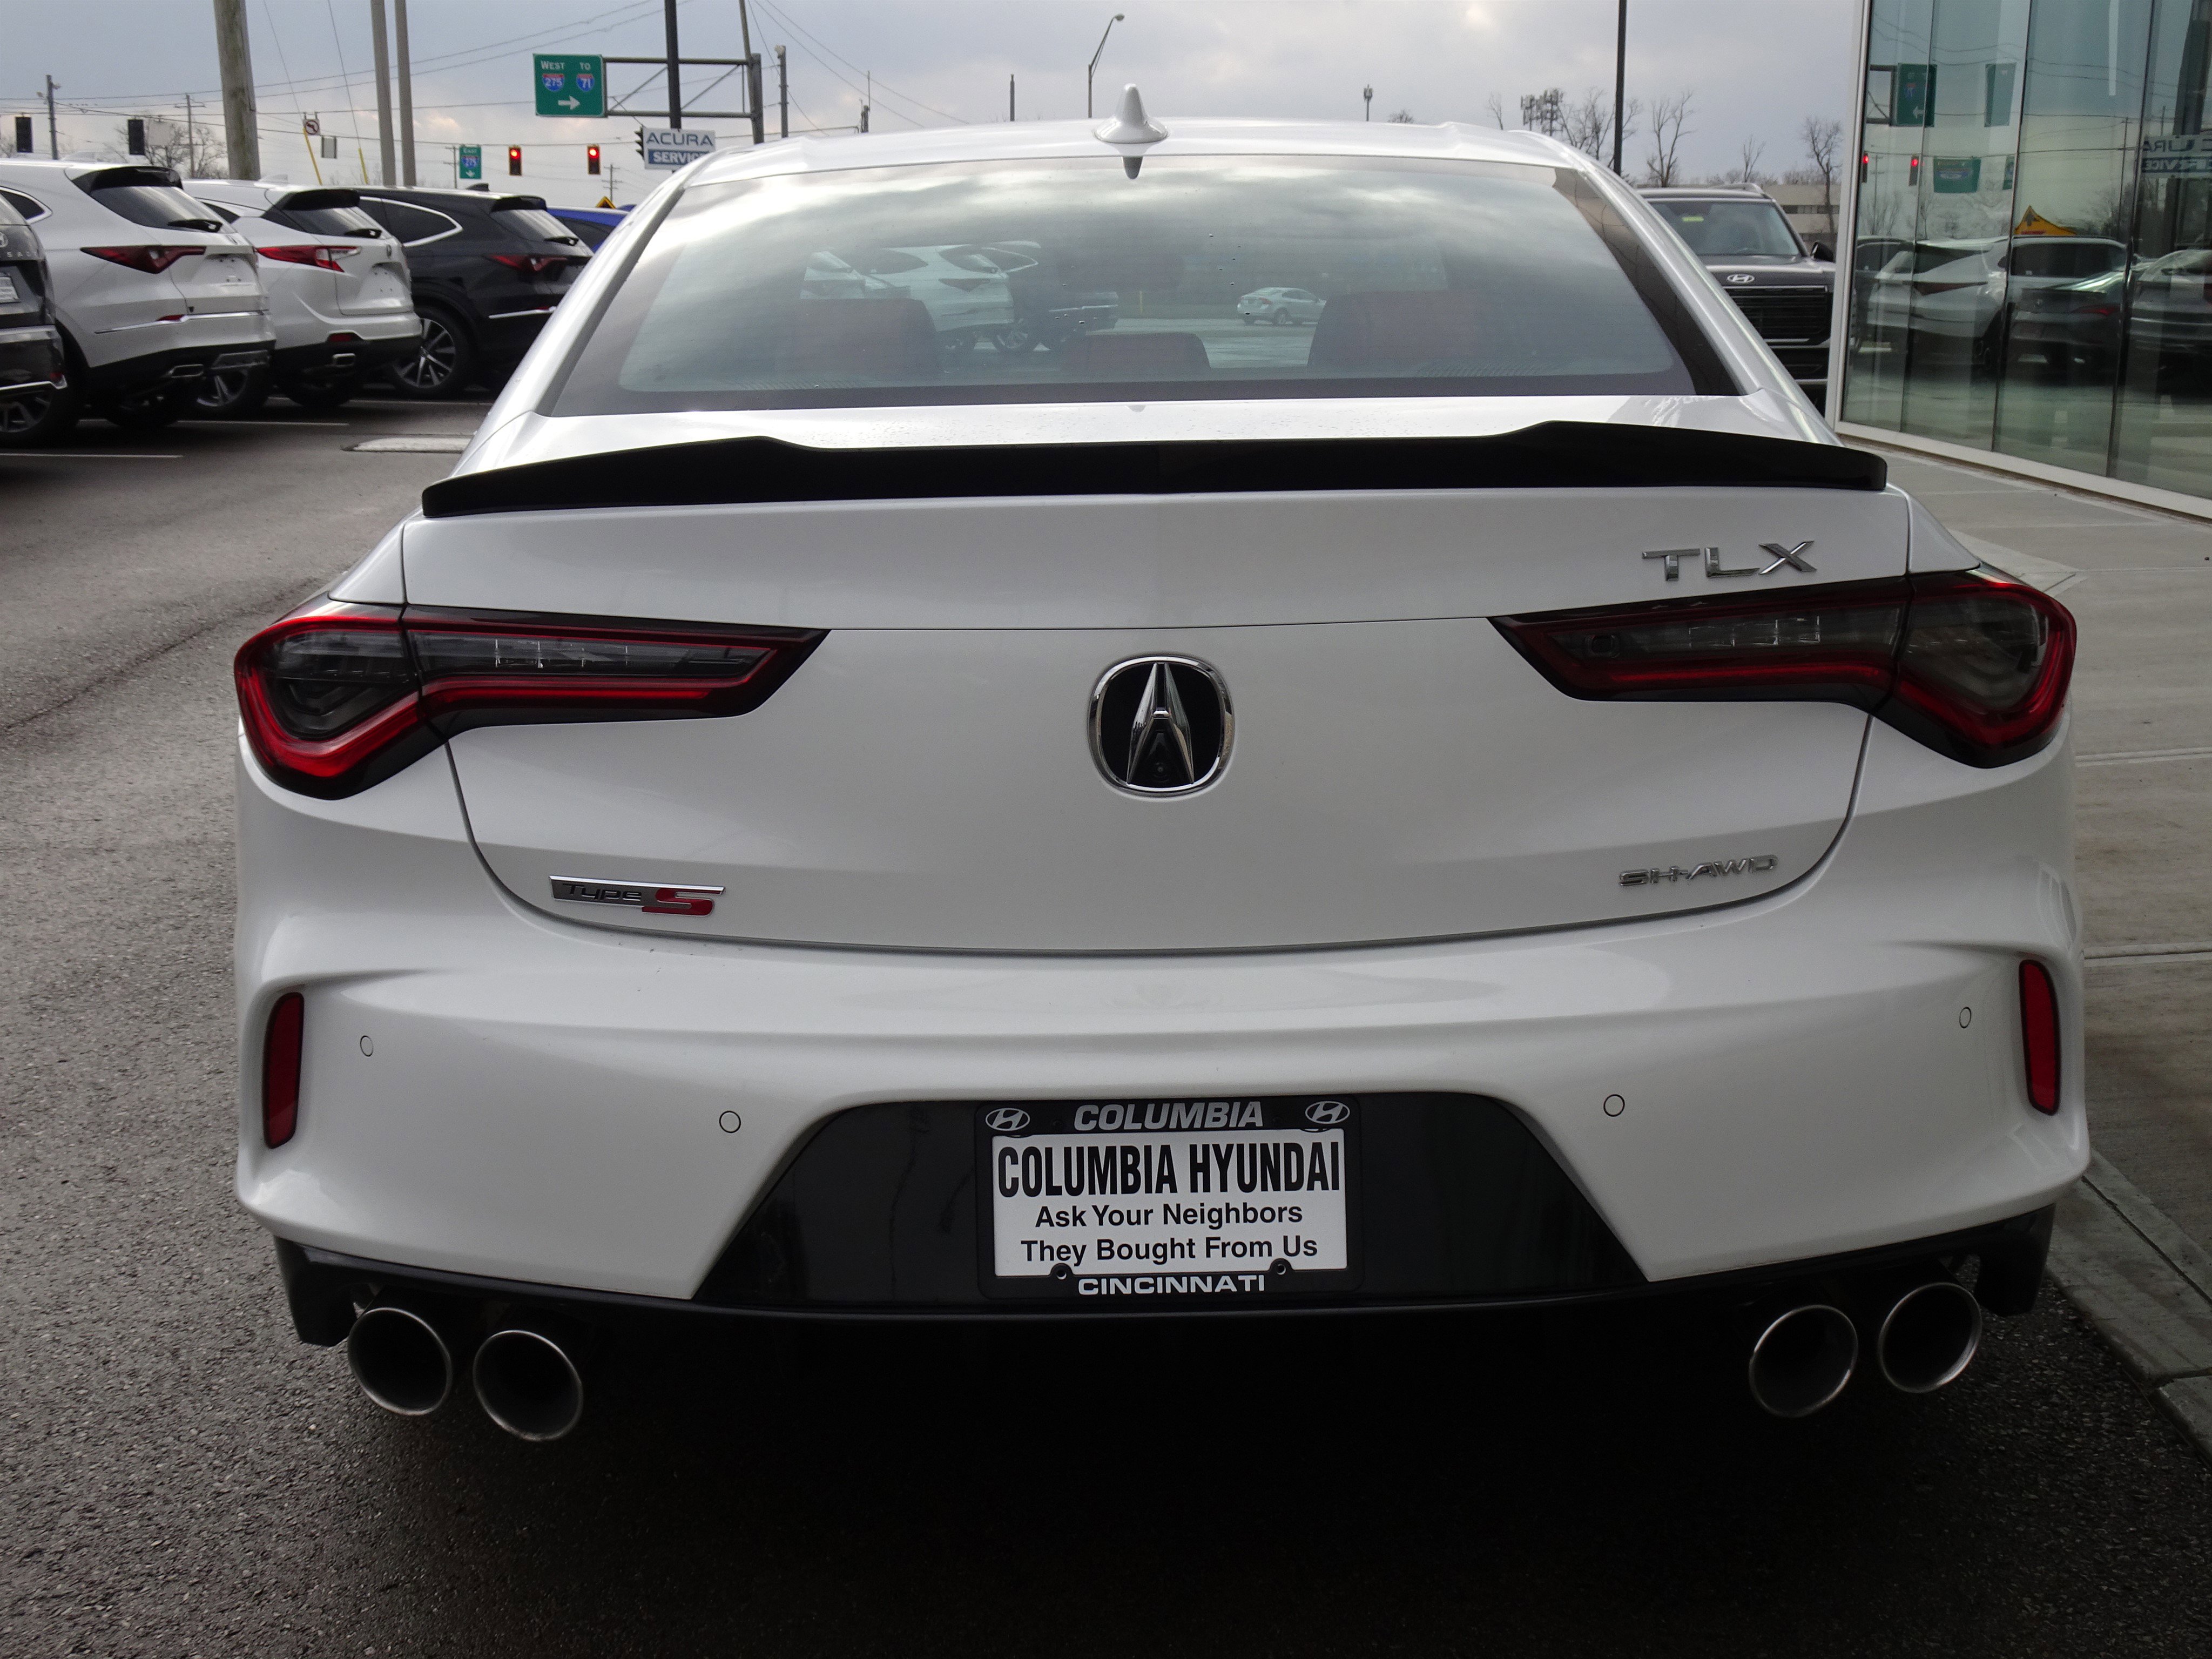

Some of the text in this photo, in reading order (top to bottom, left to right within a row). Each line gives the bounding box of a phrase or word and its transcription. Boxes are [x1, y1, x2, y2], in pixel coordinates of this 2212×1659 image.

[541, 60, 591, 71] WEST TO
[545, 77, 591, 88] 275 71
[646, 132, 713, 147] ACURA
[652, 151, 706, 163] SERVIC
[1642, 541, 1817, 582] TLX
[1618, 854, 1778, 886] SH-AWD
[641, 886, 725, 917] S
[1074, 1101, 1264, 1130] COLUMBIA
[997, 1141, 1340, 1198] COLUMBIA HYUNDAI
[1035, 1202, 1303, 1230] Ask Your Neighbors
[1021, 1235, 1318, 1266] They Bought From Us
[1078, 1274, 1265, 1296] CINCINNATI
